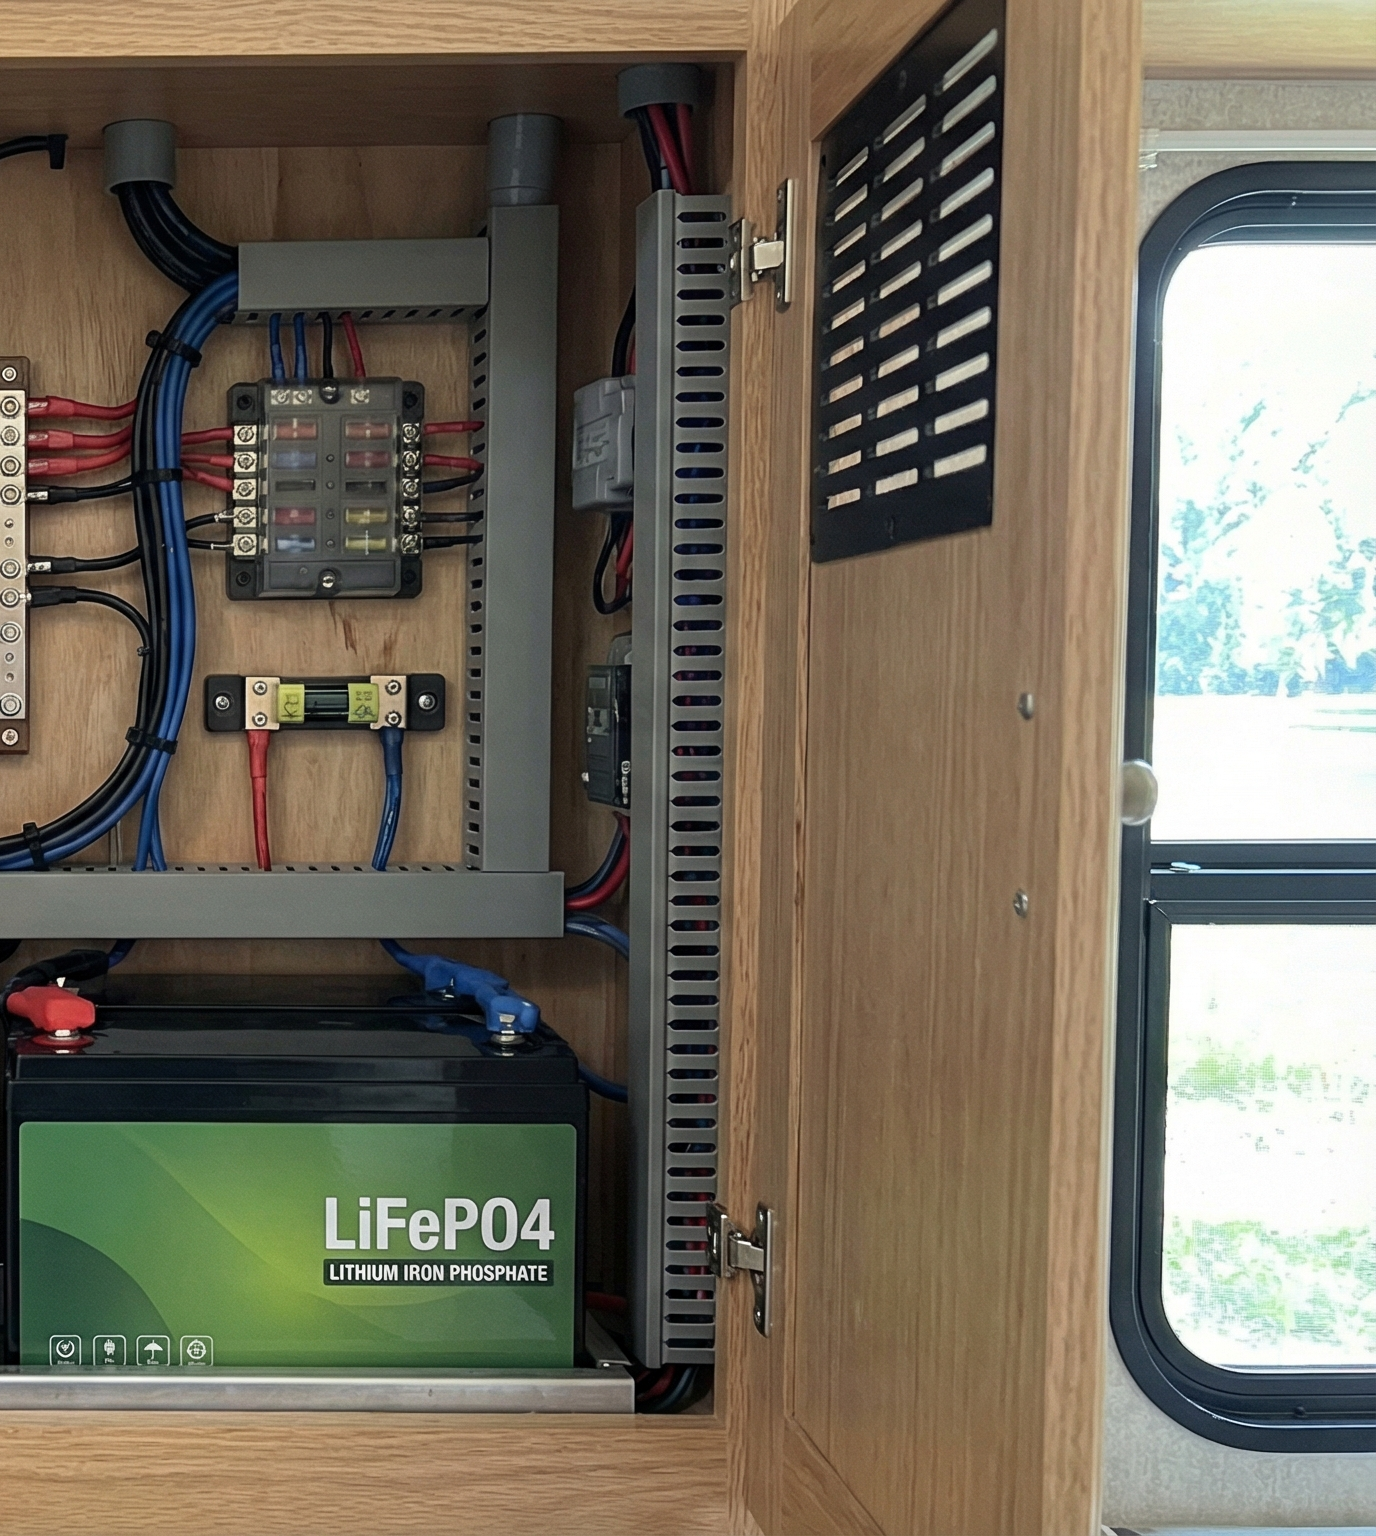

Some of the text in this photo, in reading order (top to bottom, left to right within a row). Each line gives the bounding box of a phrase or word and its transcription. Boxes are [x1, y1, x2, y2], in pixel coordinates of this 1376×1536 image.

[325, 1197, 555, 1251] LiFePO4
[329, 1264, 548, 1282] LITHIUM IRON PHOSPHATE
